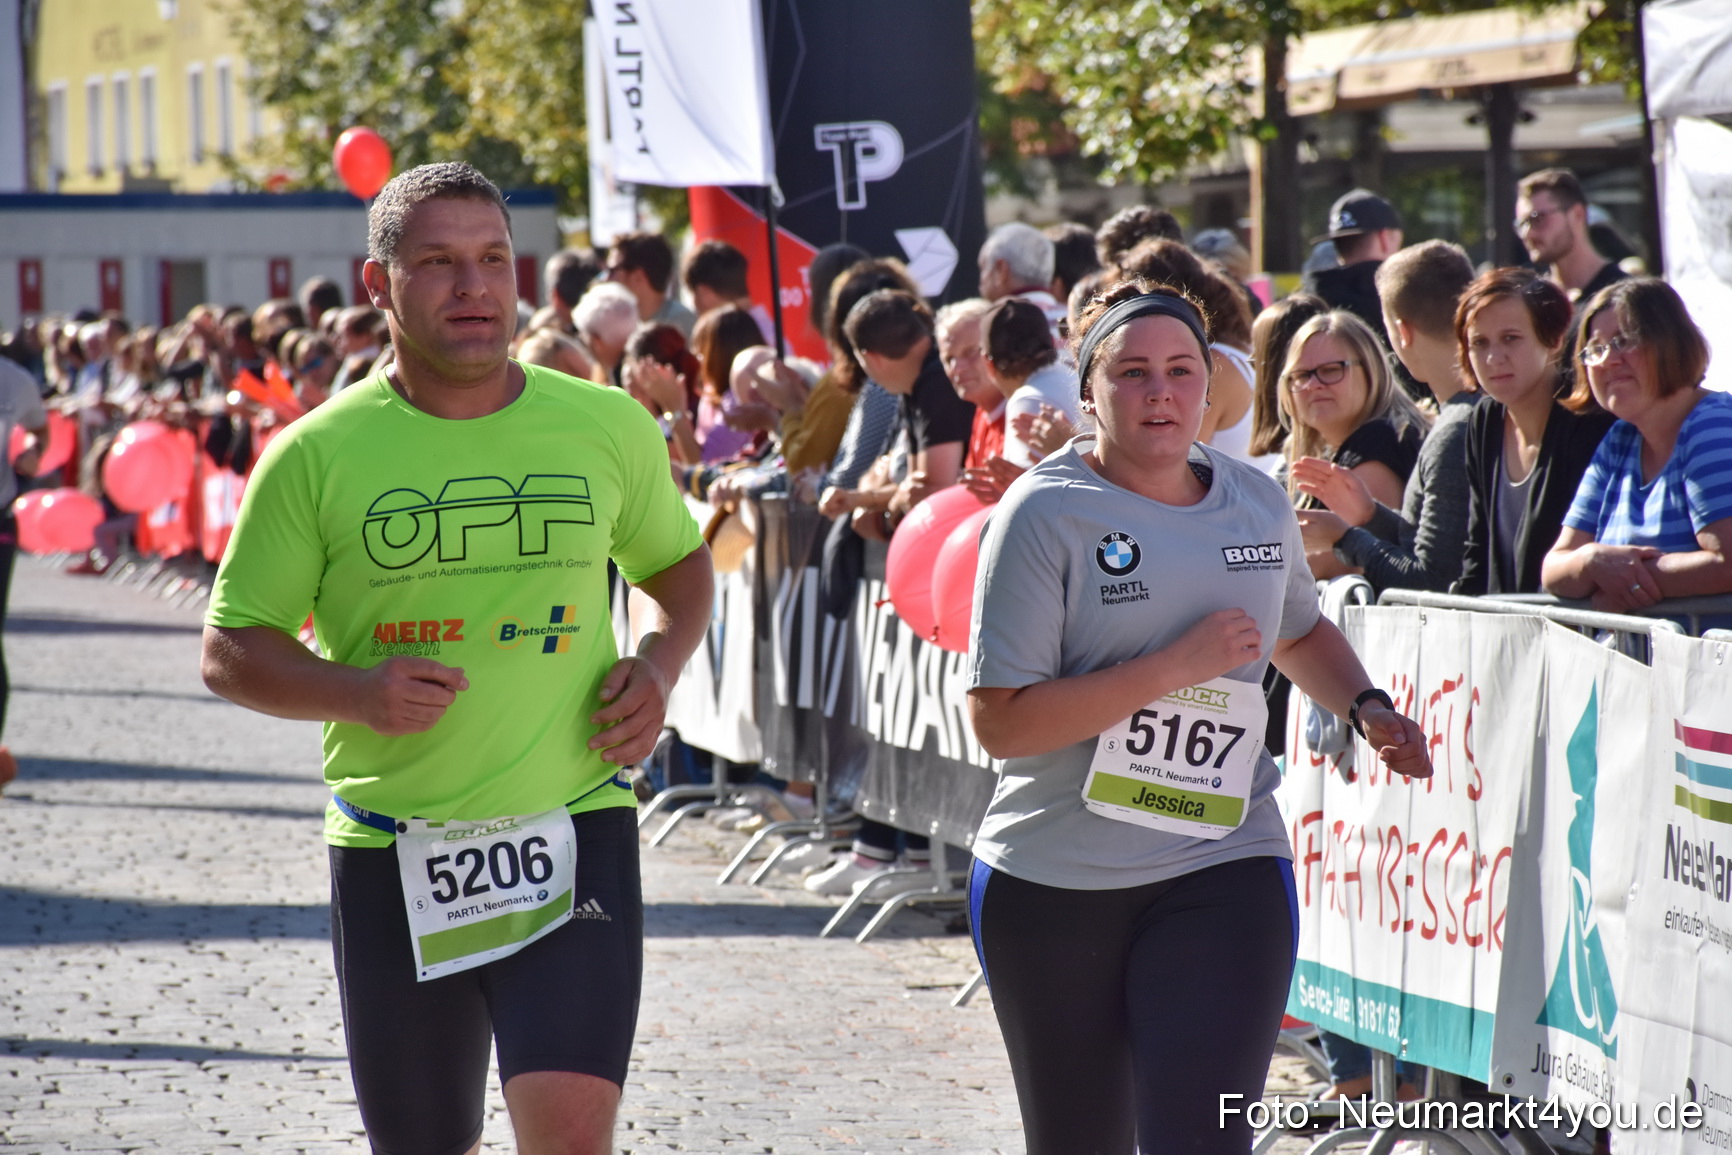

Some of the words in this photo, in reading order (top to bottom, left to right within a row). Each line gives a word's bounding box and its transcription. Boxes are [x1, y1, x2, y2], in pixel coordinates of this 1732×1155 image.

[362, 474, 595, 570] OPF
[1098, 533, 1135, 551] BMW
[1222, 543, 1283, 565] BOCK
[369, 573, 416, 589] Gebäude-
[418, 569, 437, 580] und
[439, 558, 563, 577] Automatisierungstechnik
[566, 559, 593, 569] GmbH
[1100, 580, 1149, 597] PARTL
[1102, 592, 1150, 606] Neumarkt
[373, 618, 465, 644] MERZ
[499, 623, 581, 642] Bretschneider
[369, 635, 441, 657] Reisen
[1108, 741, 1115, 750] S
[1126, 708, 1246, 770] 5167
[1129, 763, 1163, 778] PARTL
[1165, 771, 1209, 786] Neumarkt
[1132, 787, 1205, 818] Jessica
[426, 836, 554, 904] 5206
[416, 900, 424, 910] S
[447, 903, 482, 921] PARTL
[484, 895, 534, 913] Neumarkt
[1531, 1043, 1562, 1078] Jura
